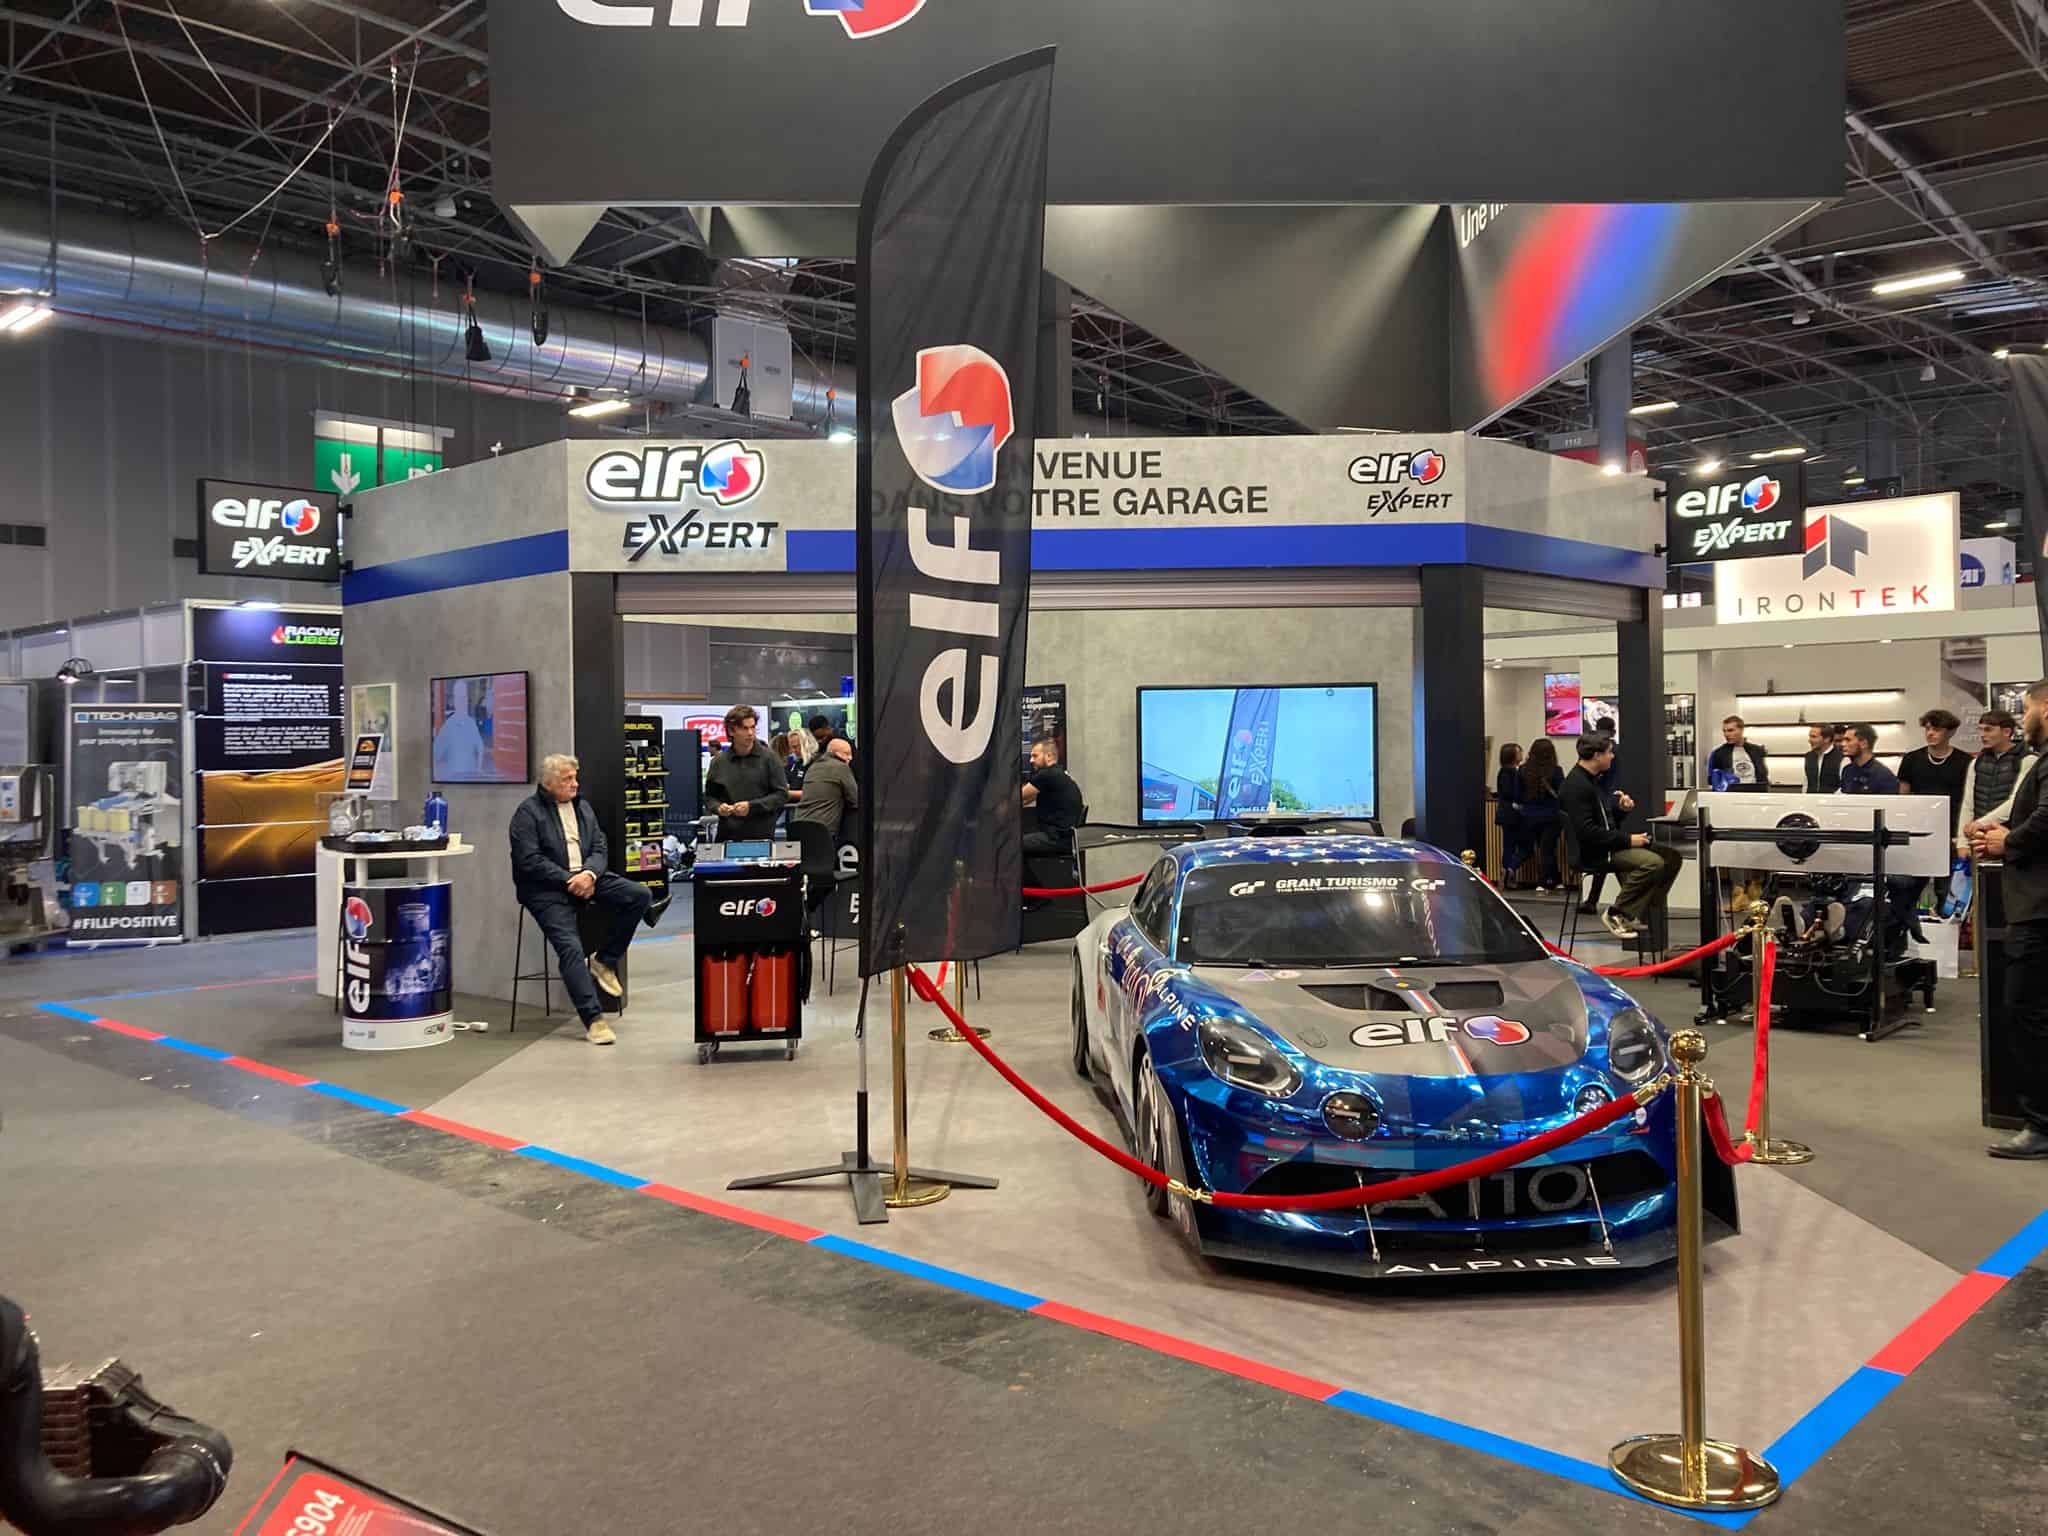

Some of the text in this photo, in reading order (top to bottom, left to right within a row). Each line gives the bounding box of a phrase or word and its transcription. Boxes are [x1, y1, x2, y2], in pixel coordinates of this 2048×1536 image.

[1461, 203, 1487, 248] Une
[587, 447, 702, 500] elf
[1348, 453, 1411, 483] elf
[212, 498, 282, 530] elf
[1112, 485, 1268, 516] GARAGE
[1367, 487, 1453, 517] EXPERT
[1676, 483, 1741, 517] elf
[232, 535, 331, 568] EXPERT
[623, 509, 779, 562] EXPERT
[1693, 517, 1792, 556] EXPERT
[1738, 584, 1929, 617] IRONTEK
[285, 626, 340, 636] RACING
[285, 635, 338, 645] LUBES
[907, 506, 1000, 764] elf
[1275, 877, 1321, 890] GRAN
[1325, 877, 1399, 888] TURISMO
[72, 915, 177, 930] #FILLPOSITIVE
[719, 899, 756, 916] elf
[346, 938, 371, 1014] elf
[1154, 982, 1197, 1031] ALPINE
[1350, 1016, 1459, 1047] elf
[1385, 1255, 1621, 1275] ALPINE
